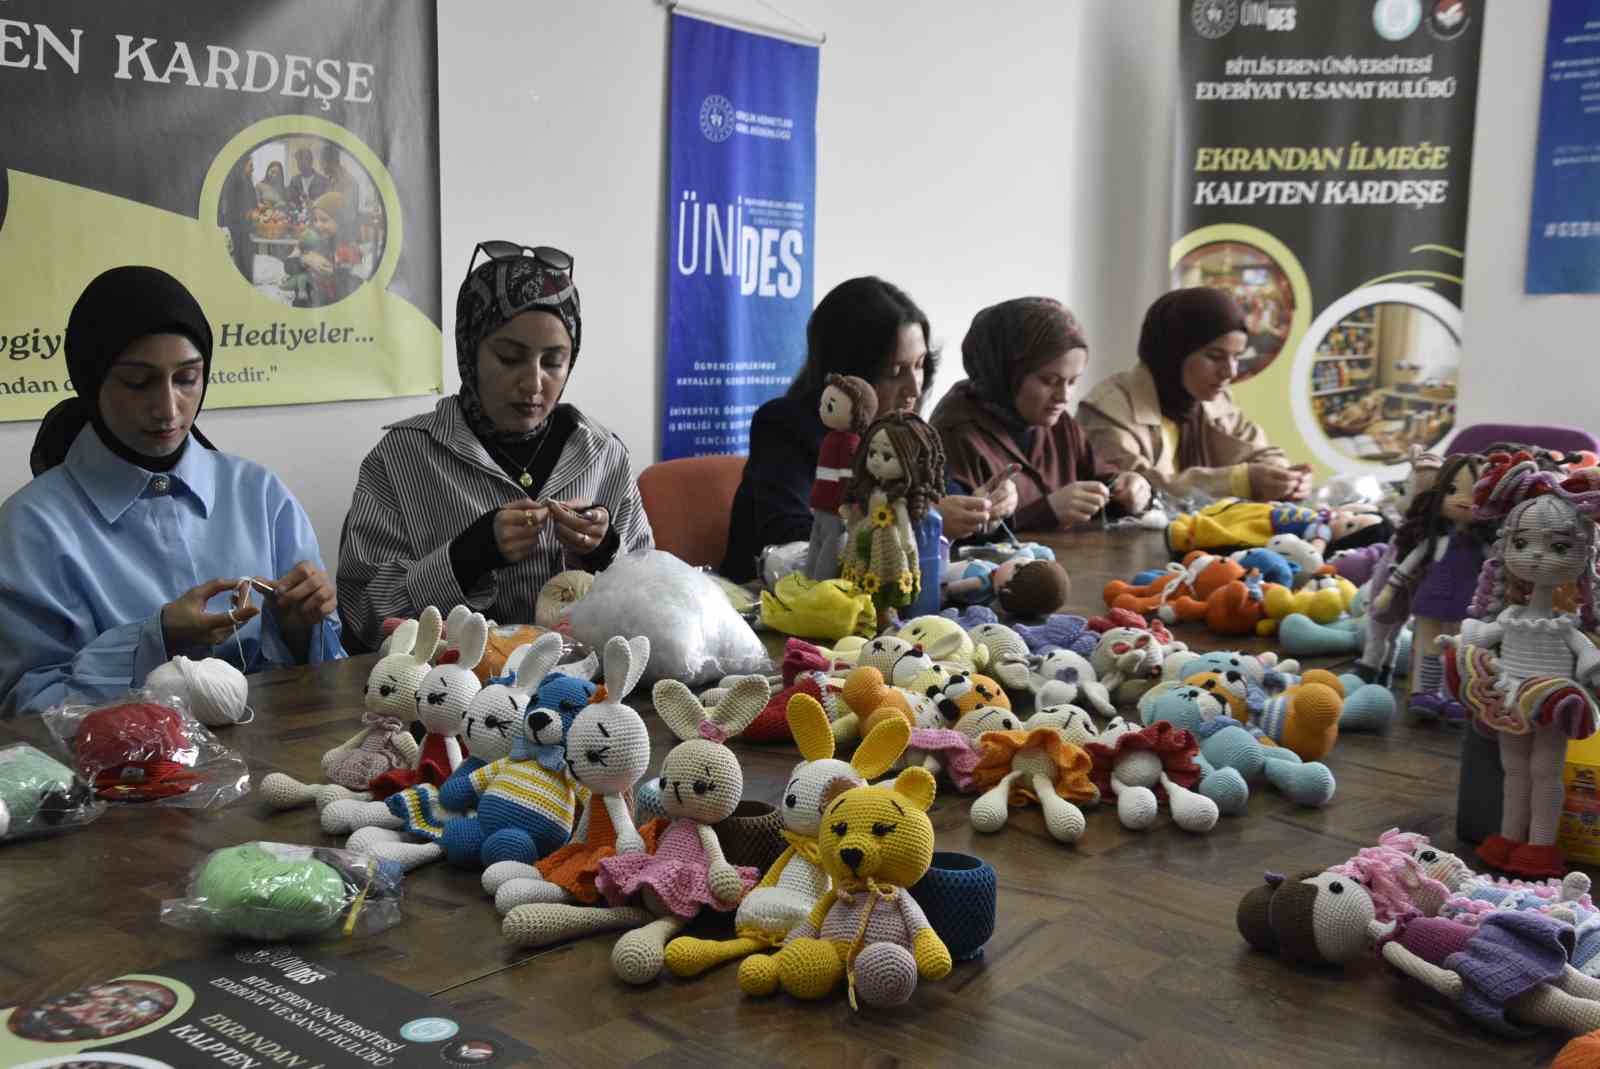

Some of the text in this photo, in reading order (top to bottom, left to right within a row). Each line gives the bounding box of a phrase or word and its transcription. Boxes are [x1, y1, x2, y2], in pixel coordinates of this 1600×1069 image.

[113, 33, 375, 110] KARDEŞE
[1225, 54, 1433, 75] BİTLİS EREN ÜNİVERSİTESİ
[1195, 76, 1457, 100] EDEBİYAT VE SANAT KULÜBÜ
[1194, 142, 1450, 171] EKRANDAN İLMEĞE
[1193, 180, 1449, 209] KALPTEN KARDEŞE
[219, 321, 375, 351] Hediyeler...
[267, 1002, 296, 1017] VE
[283, 1010, 337, 1039] SANAT
[277, 991, 319, 1012] EREN
[311, 1007, 407, 1054] ÜNİVERSİTESİ
[168, 1023, 263, 1069] KALPTEN
[200, 1013, 308, 1068] EKRANDAN
